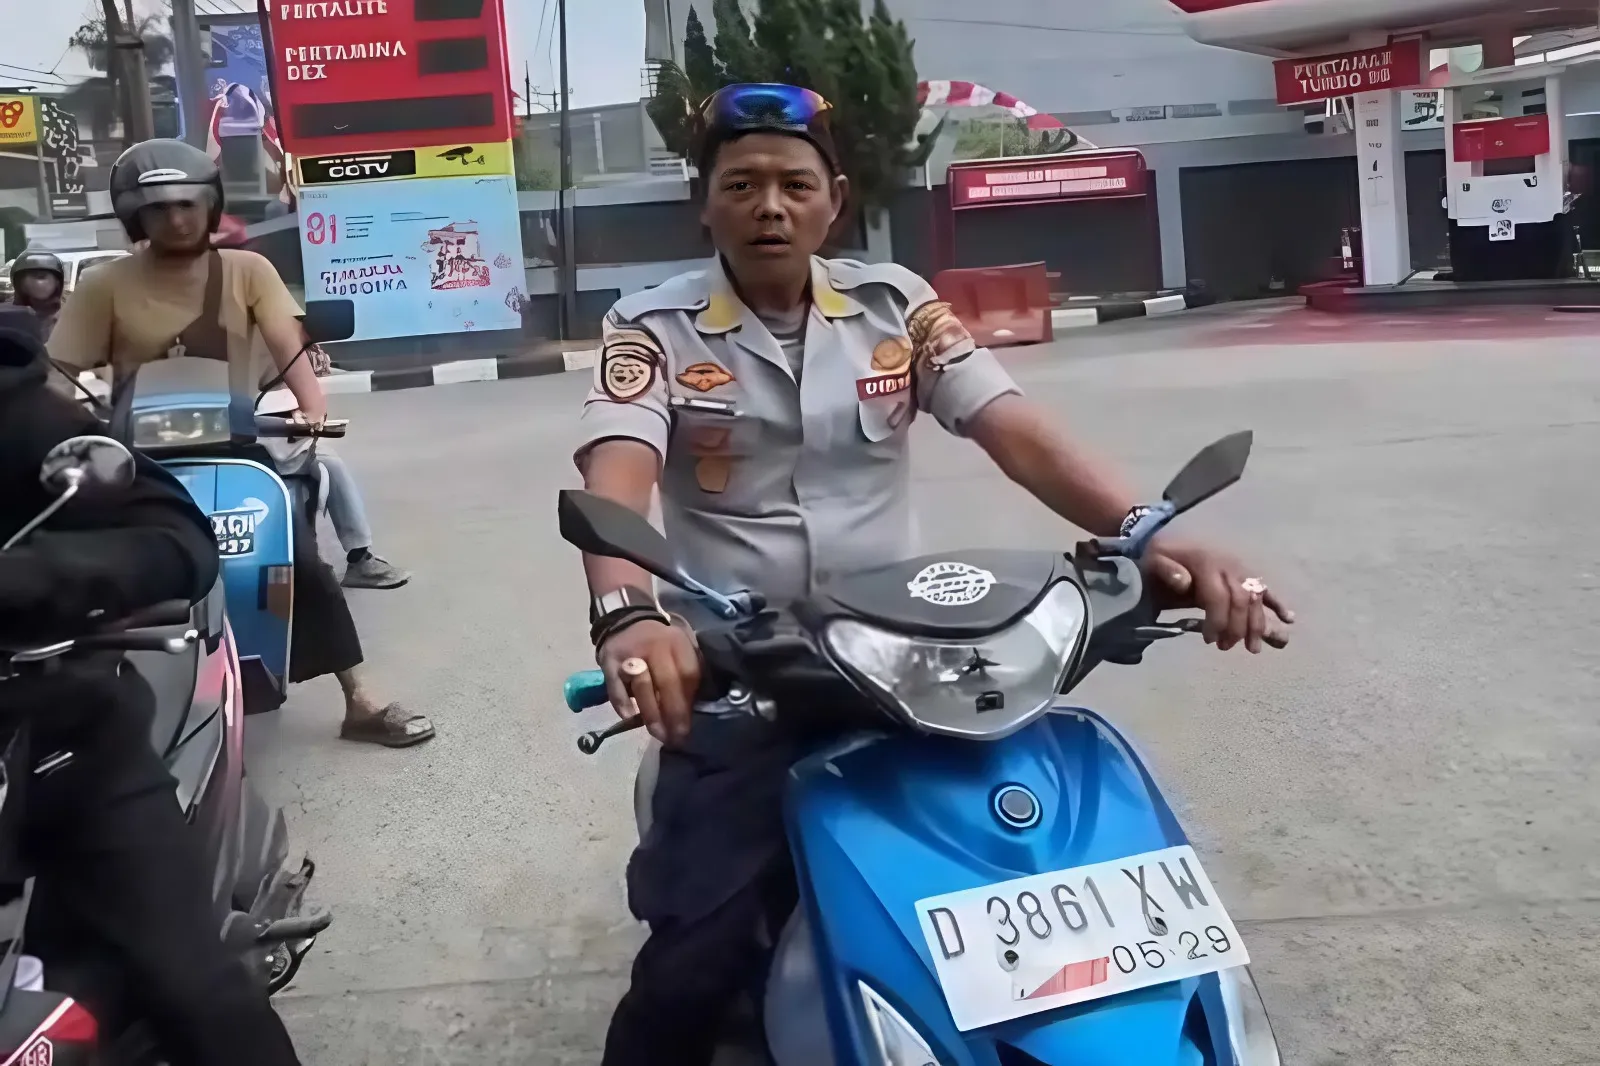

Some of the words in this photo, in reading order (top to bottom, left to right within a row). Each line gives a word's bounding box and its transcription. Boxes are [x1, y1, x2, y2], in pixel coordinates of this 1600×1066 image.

[928, 907, 965, 960] D
[986, 875, 1116, 947] 3861
[1120, 856, 1209, 914] XW
